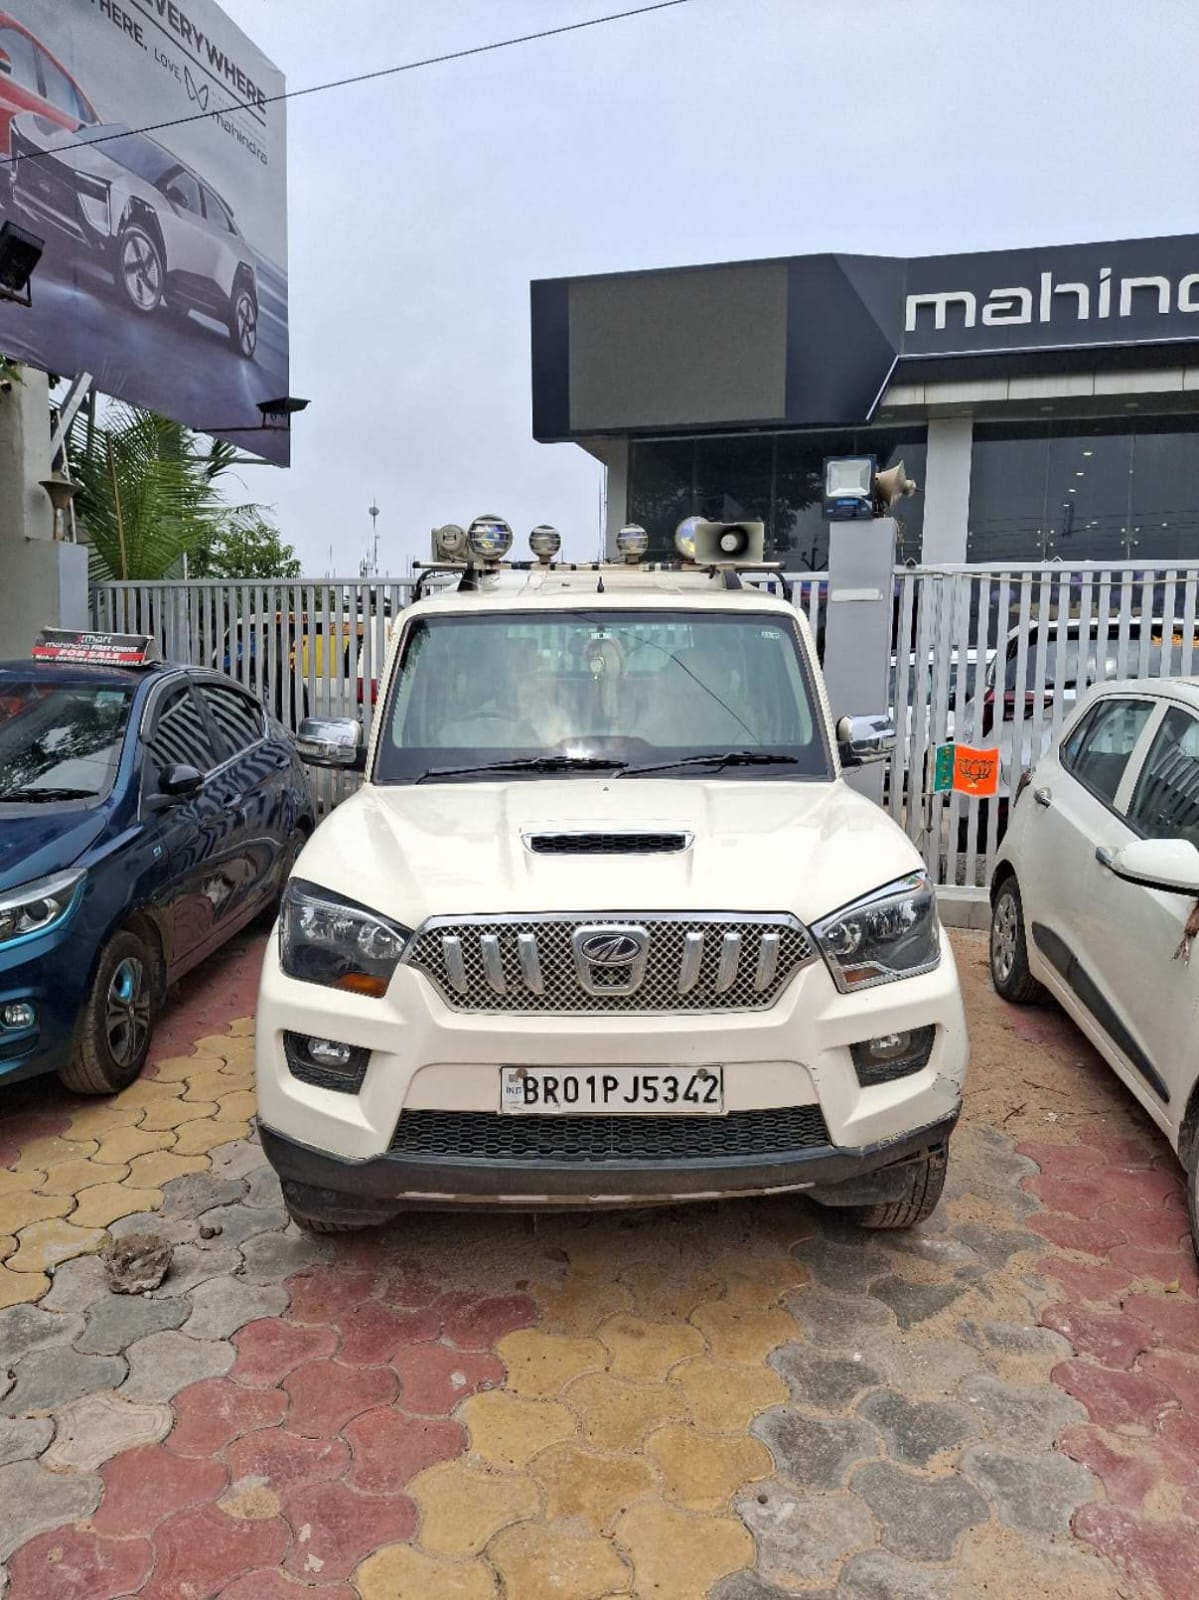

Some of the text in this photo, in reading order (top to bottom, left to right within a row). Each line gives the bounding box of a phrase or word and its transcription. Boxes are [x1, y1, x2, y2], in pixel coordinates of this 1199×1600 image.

[91, 0, 148, 51] HERE.
[145, 0, 266, 115] VERYWHERE
[58, 649, 85, 658] FOR
[86, 651, 120, 660] SALE
[522, 1075, 719, 1105] BR01PJ5342
